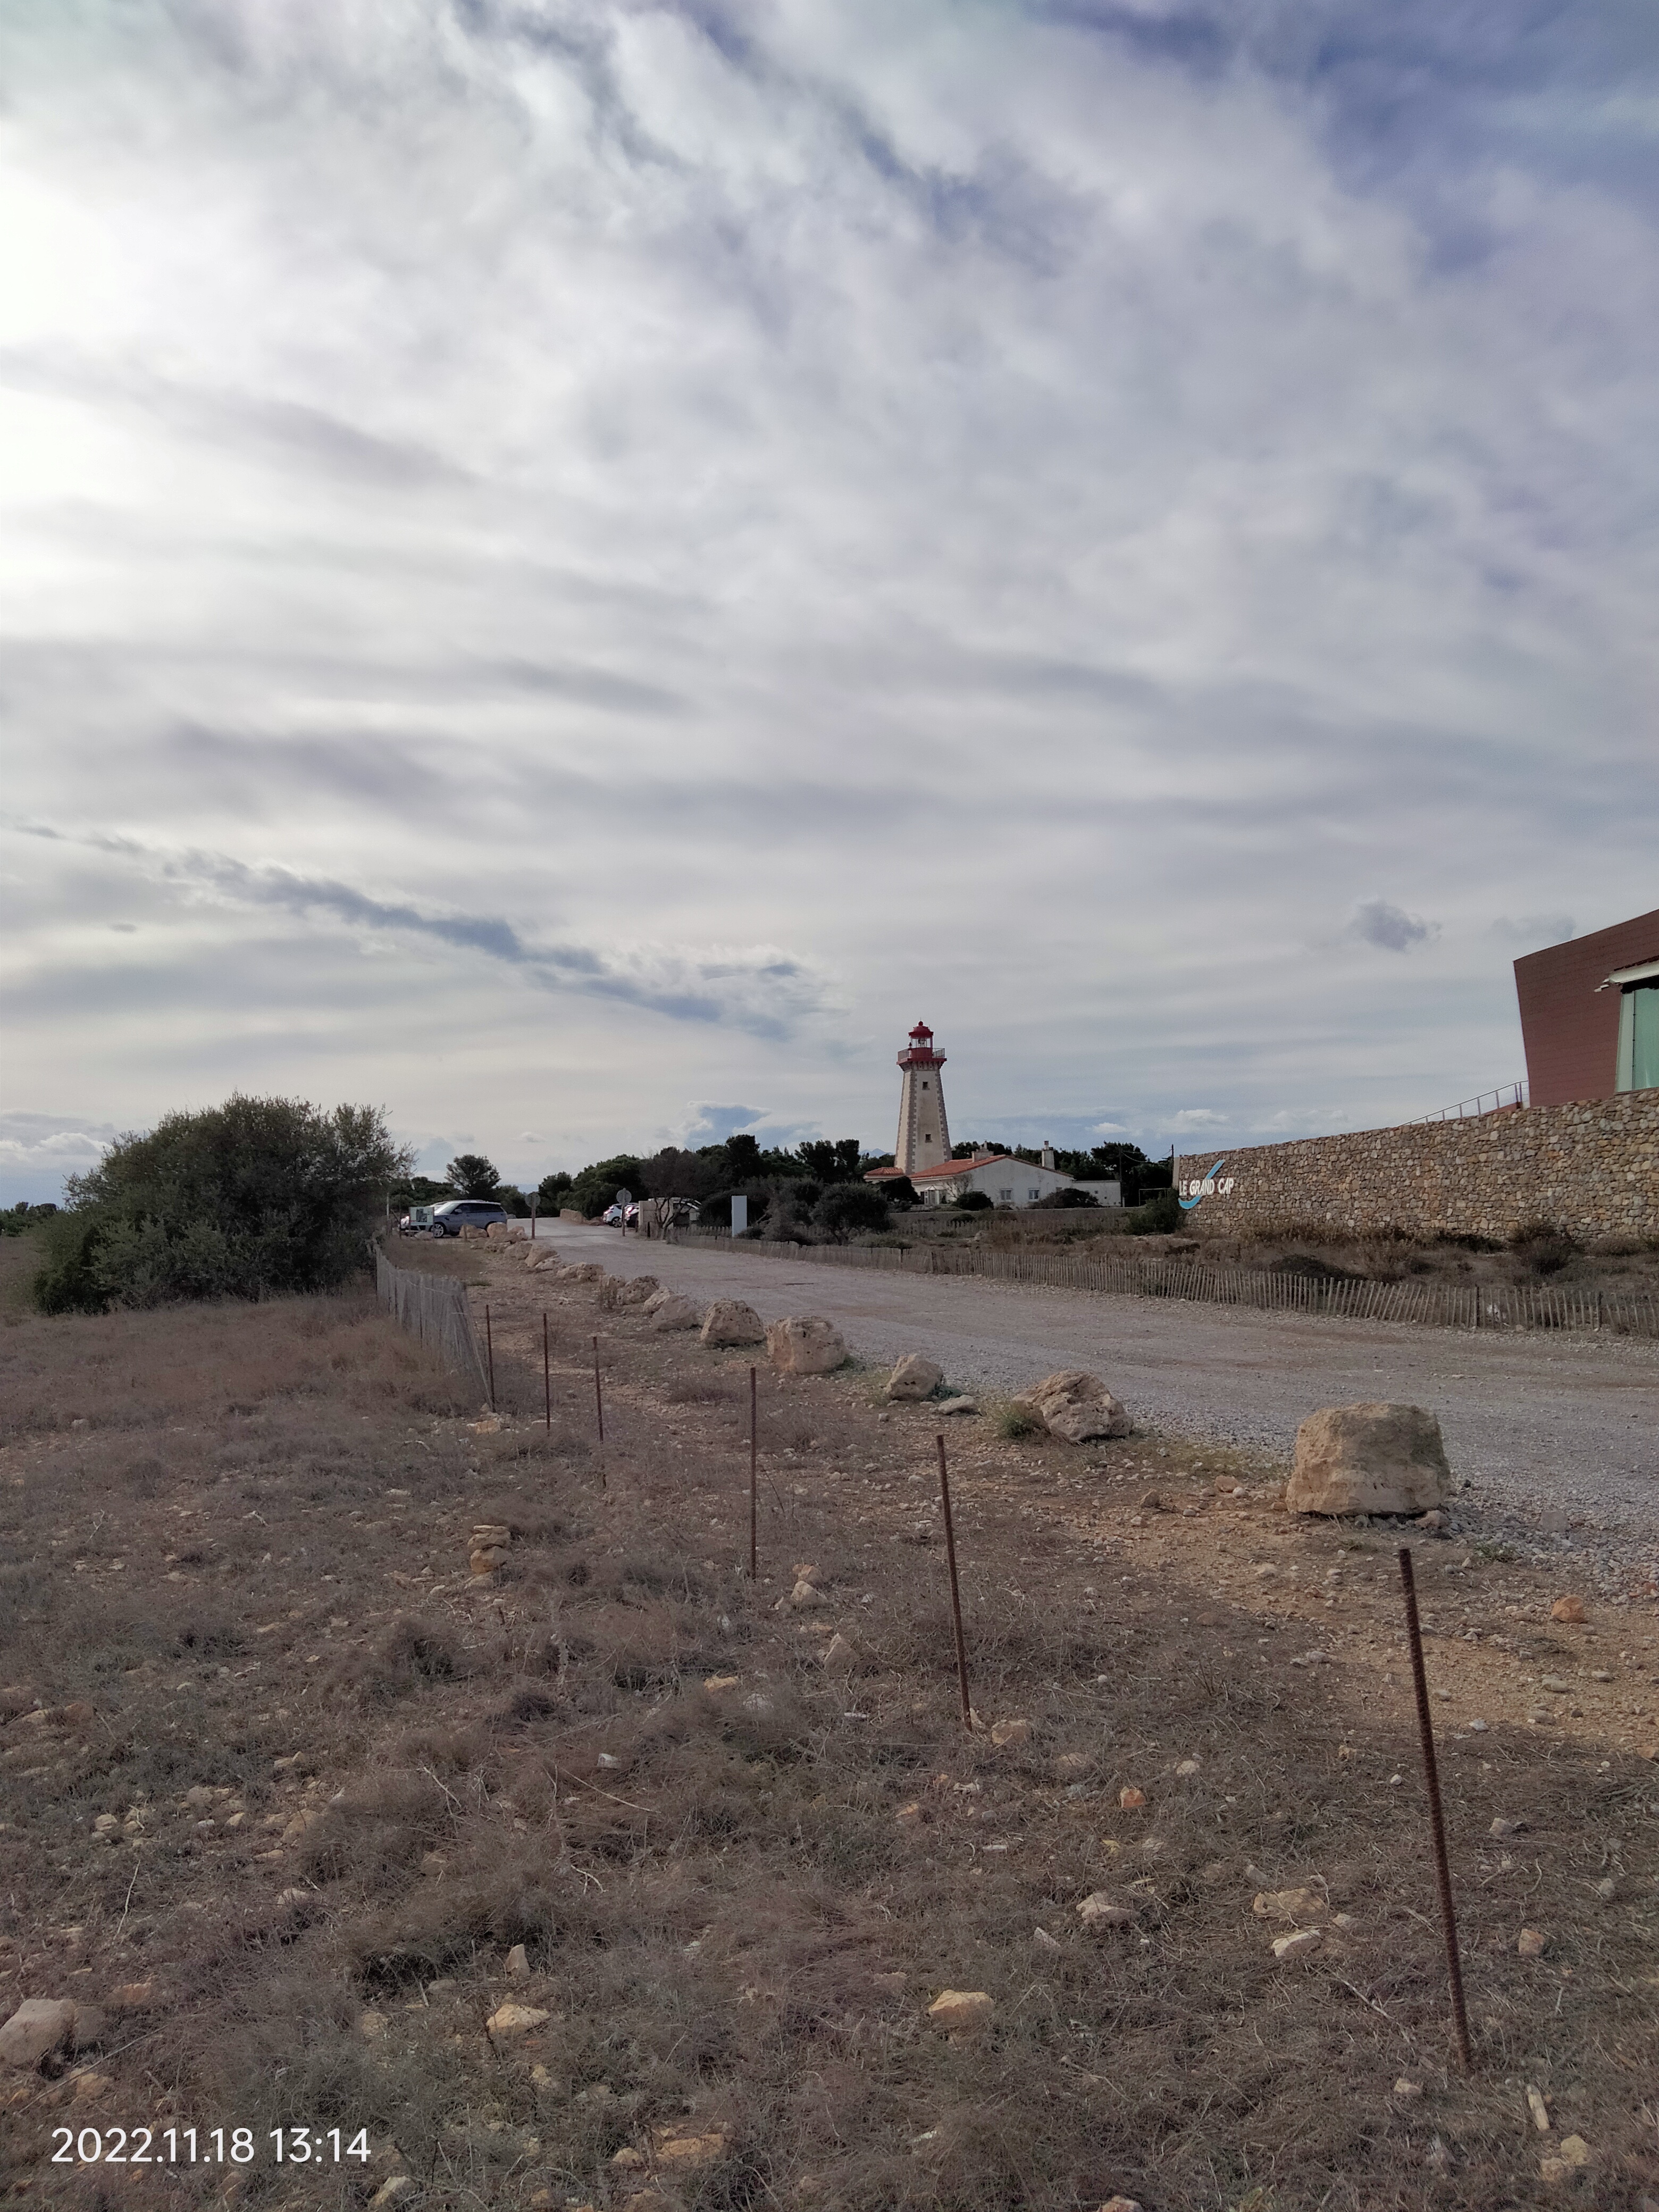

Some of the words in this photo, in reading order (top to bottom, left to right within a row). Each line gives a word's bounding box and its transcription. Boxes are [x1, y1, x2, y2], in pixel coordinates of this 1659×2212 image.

[1179, 1180, 1187, 1196] LE
[1189, 1179, 1214, 1196] GRAND
[1218, 1177, 1234, 1194] CAP
